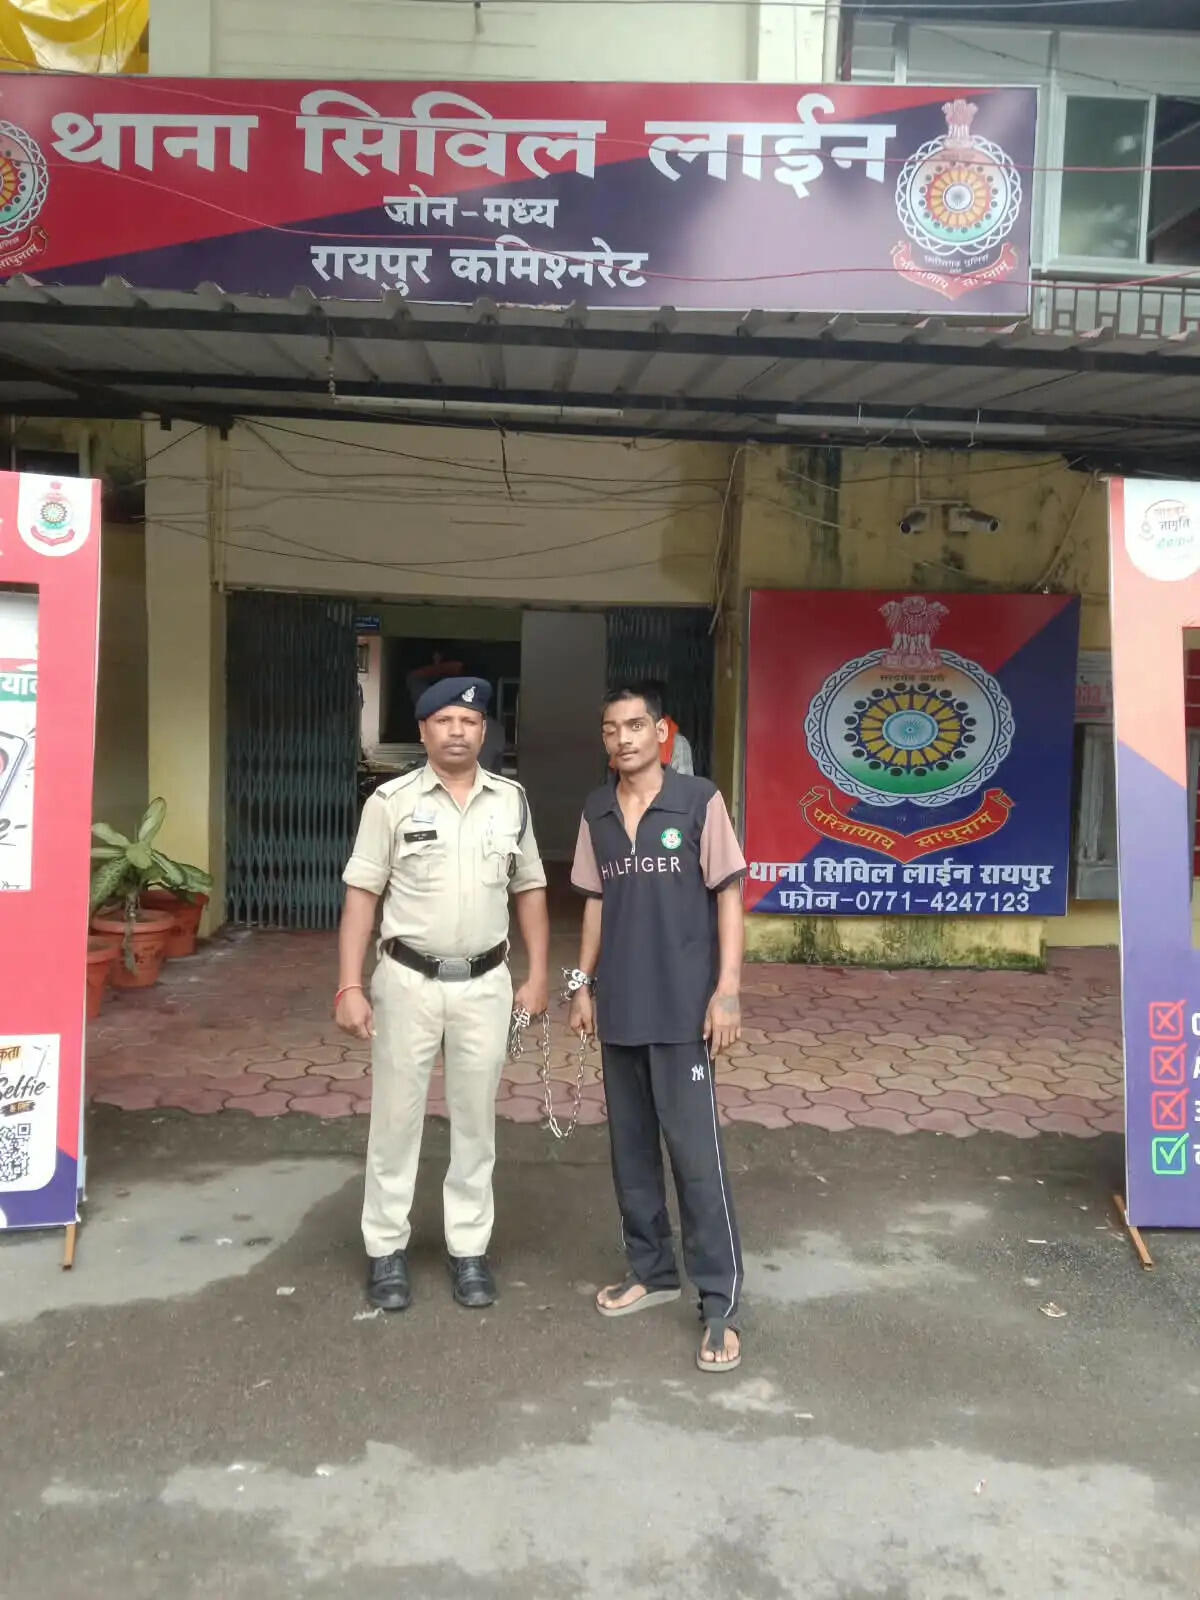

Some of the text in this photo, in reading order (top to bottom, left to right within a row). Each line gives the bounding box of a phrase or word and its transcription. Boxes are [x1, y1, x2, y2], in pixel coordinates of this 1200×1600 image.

[51, 89, 897, 198] थाना सिविल लाईन
[310, 233, 649, 297] रायपुर कमिश्नरेट
[601, 856, 682, 881] HILFIGER
[749, 857, 1055, 893] थाना सिविल लाईन रायपुर
